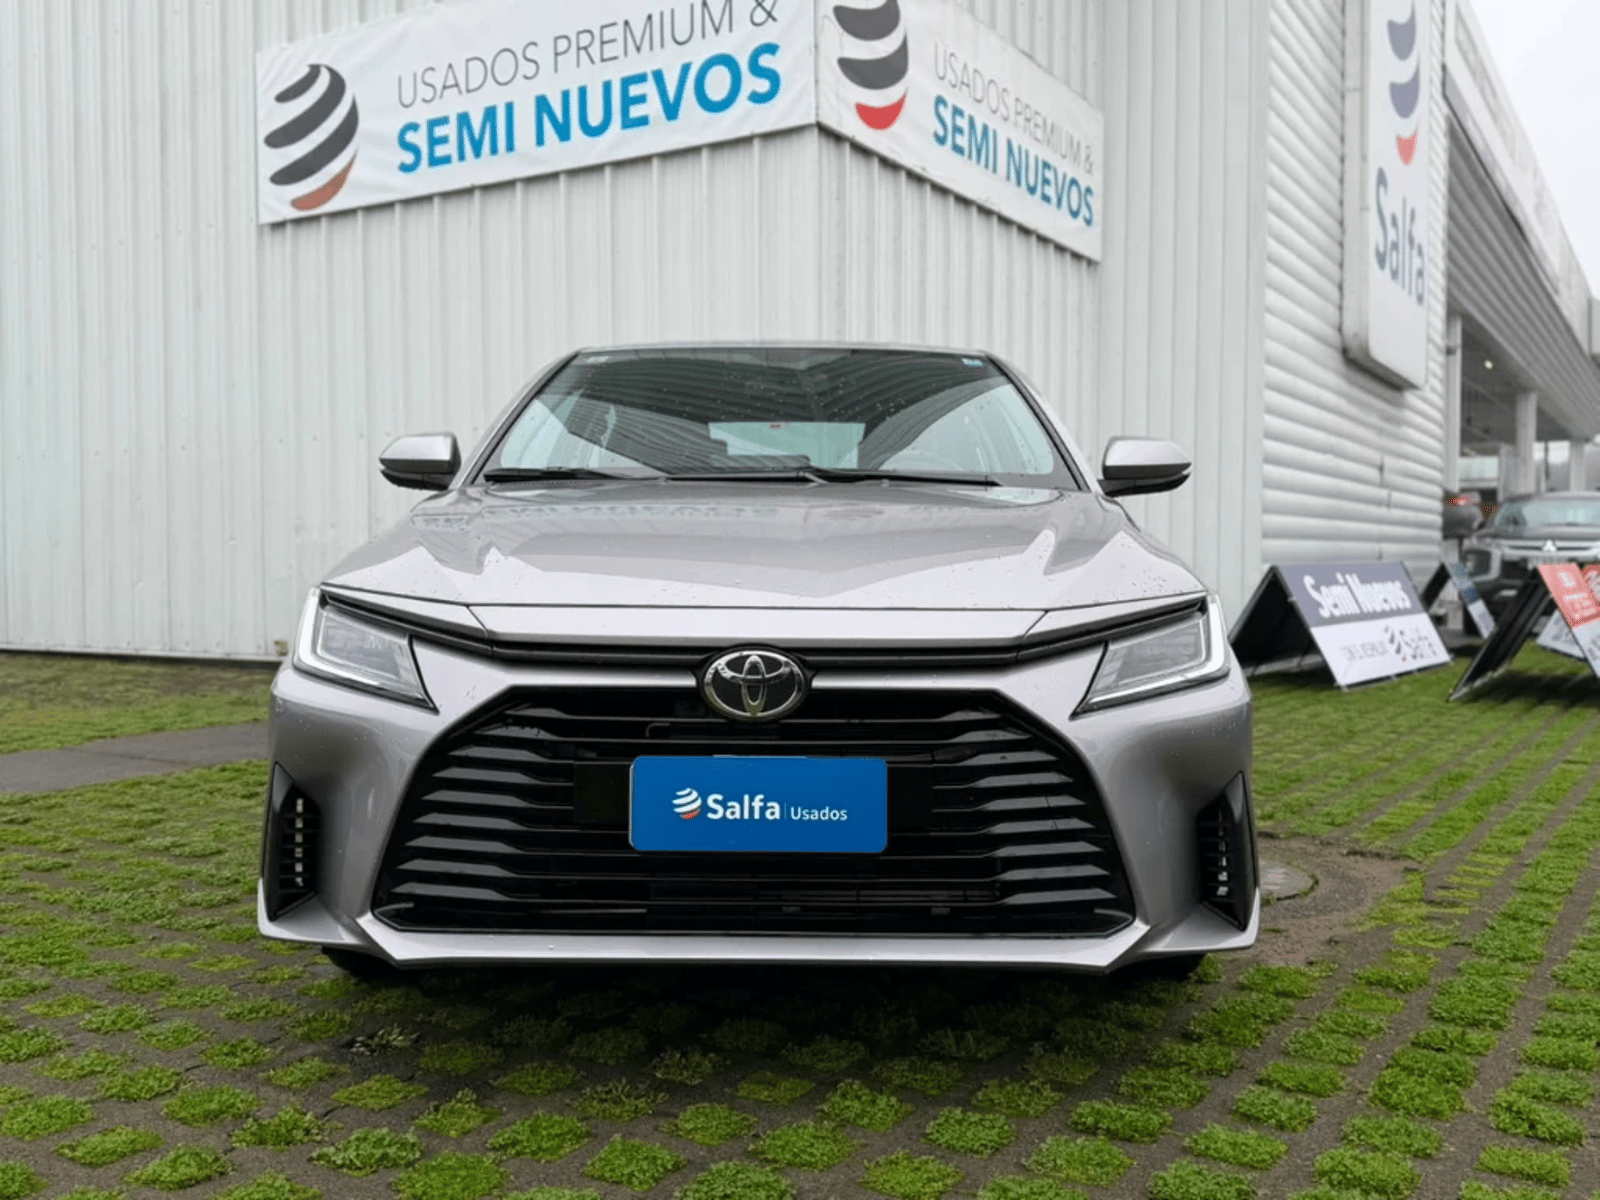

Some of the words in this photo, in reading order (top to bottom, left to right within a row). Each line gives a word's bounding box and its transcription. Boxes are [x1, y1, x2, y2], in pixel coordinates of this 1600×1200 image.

[396, 41, 541, 108] USADOS
[552, 0, 734, 75] PREMIUM
[749, 0, 779, 27] &
[396, 101, 515, 174] SEMI
[534, 41, 782, 148] NUEVOS
[934, 42, 1010, 122] USADOS
[1013, 96, 1081, 169] PREMIUM
[933, 94, 997, 175] SEMI
[1005, 137, 1094, 228] NUEVOS
[1375, 166, 1425, 306] Salfa
[706, 793, 781, 820] Salfa
[789, 805, 848, 821] Usados
